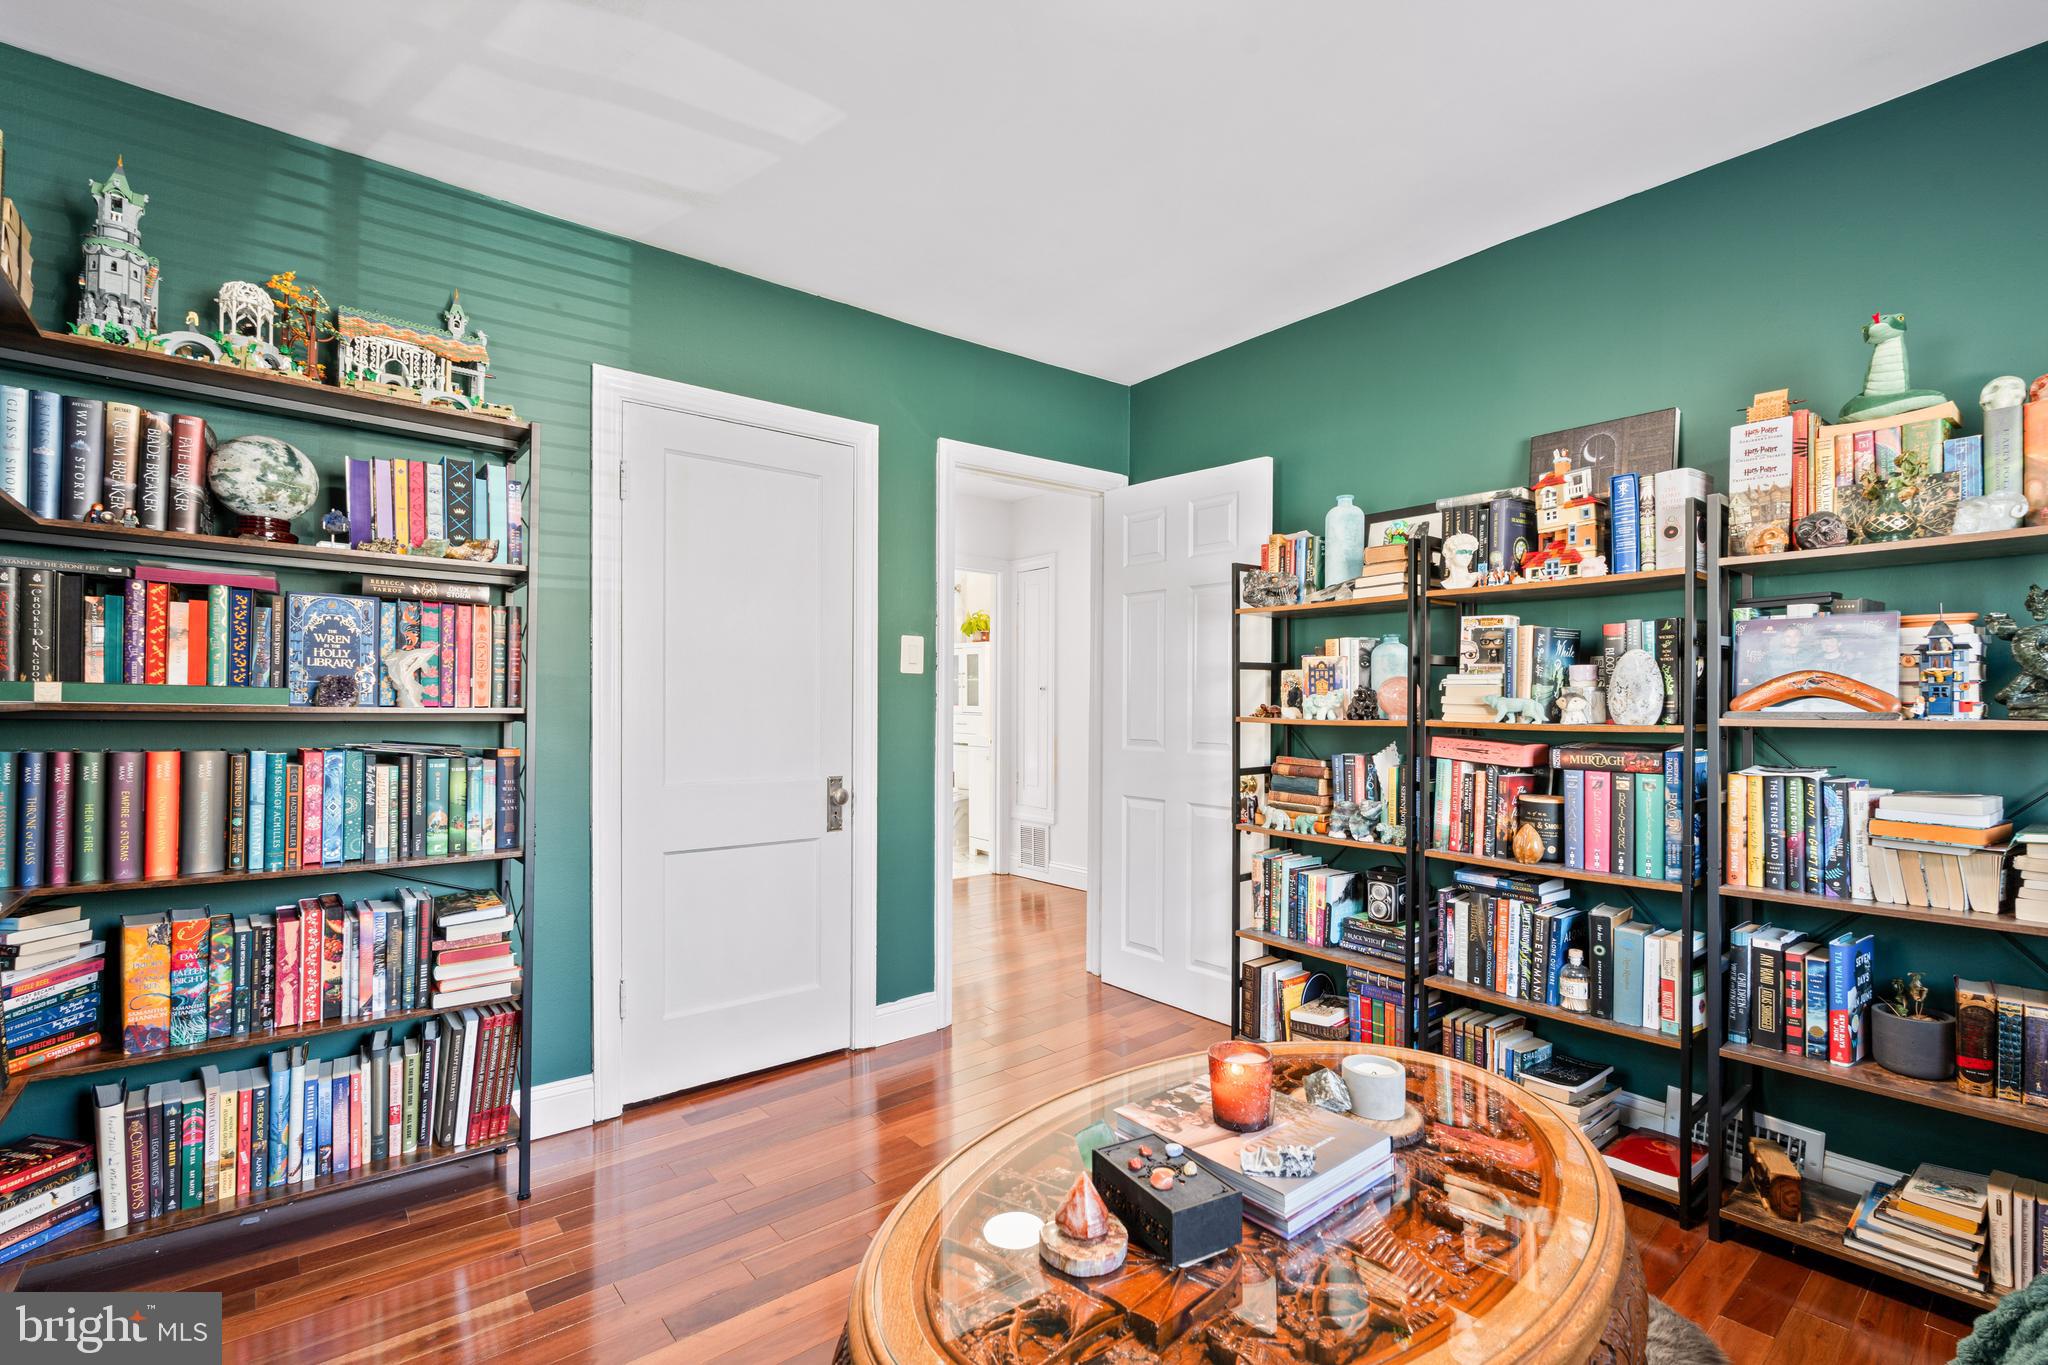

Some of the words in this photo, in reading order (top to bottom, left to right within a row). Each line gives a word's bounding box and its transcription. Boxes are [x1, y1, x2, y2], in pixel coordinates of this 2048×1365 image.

[74, 410, 88, 436] WAR
[114, 417, 129, 458] REALM
[1744, 429, 1759, 437] Harry
[146, 428, 162, 465] BLADE
[178, 436, 192, 466] FATE
[1744, 448, 1759, 456] Harry
[74, 456, 86, 501] STORM
[1744, 468, 1759, 476] Harry
[110, 460, 128, 510] BREAKER
[142, 466, 160, 512] BREAKER
[175, 468, 190, 511] BREAKER
[44, 561, 58, 569] THE
[60, 562, 84, 570] STONE
[370, 578, 406, 587] REBECCA
[29, 588, 44, 636] CROOKED
[314, 634, 350, 644] WREN
[314, 648, 351, 657] HOLLY
[307, 657, 356, 669] LIBRARY
[1570, 752, 1624, 768] MURTAGH
[234, 762, 242, 784] STONE
[26, 796, 37, 830] THRONE
[56, 790, 66, 821] CROWN
[84, 804, 94, 823] HEIR
[120, 790, 130, 818] EMPIRE
[274, 800, 281, 810] OF
[252, 808, 262, 856] ATALANTA
[273, 812, 281, 848] ACHILLES
[25, 841, 36, 865] GLASS
[55, 829, 65, 868] MIDNIGHT
[84, 835, 94, 854] FIRE
[120, 830, 130, 862] STORMS
[1808, 838, 1818, 866] GUEST
[1808, 867, 1818, 882] LIST
[179, 952, 200, 962] DAY
[1535, 943, 1543, 963] EVE
[1760, 954, 1774, 967] AYN
[1856, 952, 1871, 966] SEVEN
[172, 967, 208, 978] FALLEN
[174, 975, 204, 986] NIGHT
[1534, 969, 1542, 993] MAN
[1760, 968, 1774, 984] RAND
[1857, 971, 1869, 987] DAYS
[16, 994, 32, 1002] WHAT
[33, 986, 55, 996] BECAME
[1664, 991, 1672, 1007] NATIVE
[1737, 972, 1746, 1008] CHILDREN
[1762, 990, 1772, 1004] ATLAS
[128, 1006, 168, 1018] SAMANTHA
[171, 1002, 206, 1011] SAMANTHA
[171, 1006, 206, 1016] SHANNON
[1663, 1008, 1672, 1019] SON
[127, 1012, 168, 1022] SHANNON
[1762, 1005, 1772, 1029] SHRUGGED
[15, 1048, 27, 1056] THIS
[29, 1038, 56, 1052] WRETCHED
[57, 1032, 76, 1042] VALLEY
[46, 1041, 86, 1058] CHRISTINA
[450, 1066, 458, 1101] ILLUSTRATED
[57, 1156, 77, 1168] BREATH
[130, 1131, 144, 1180] CEMETERY
[28, 1174, 76, 1198] DROWNING
[131, 1182, 145, 1210] BOYS
